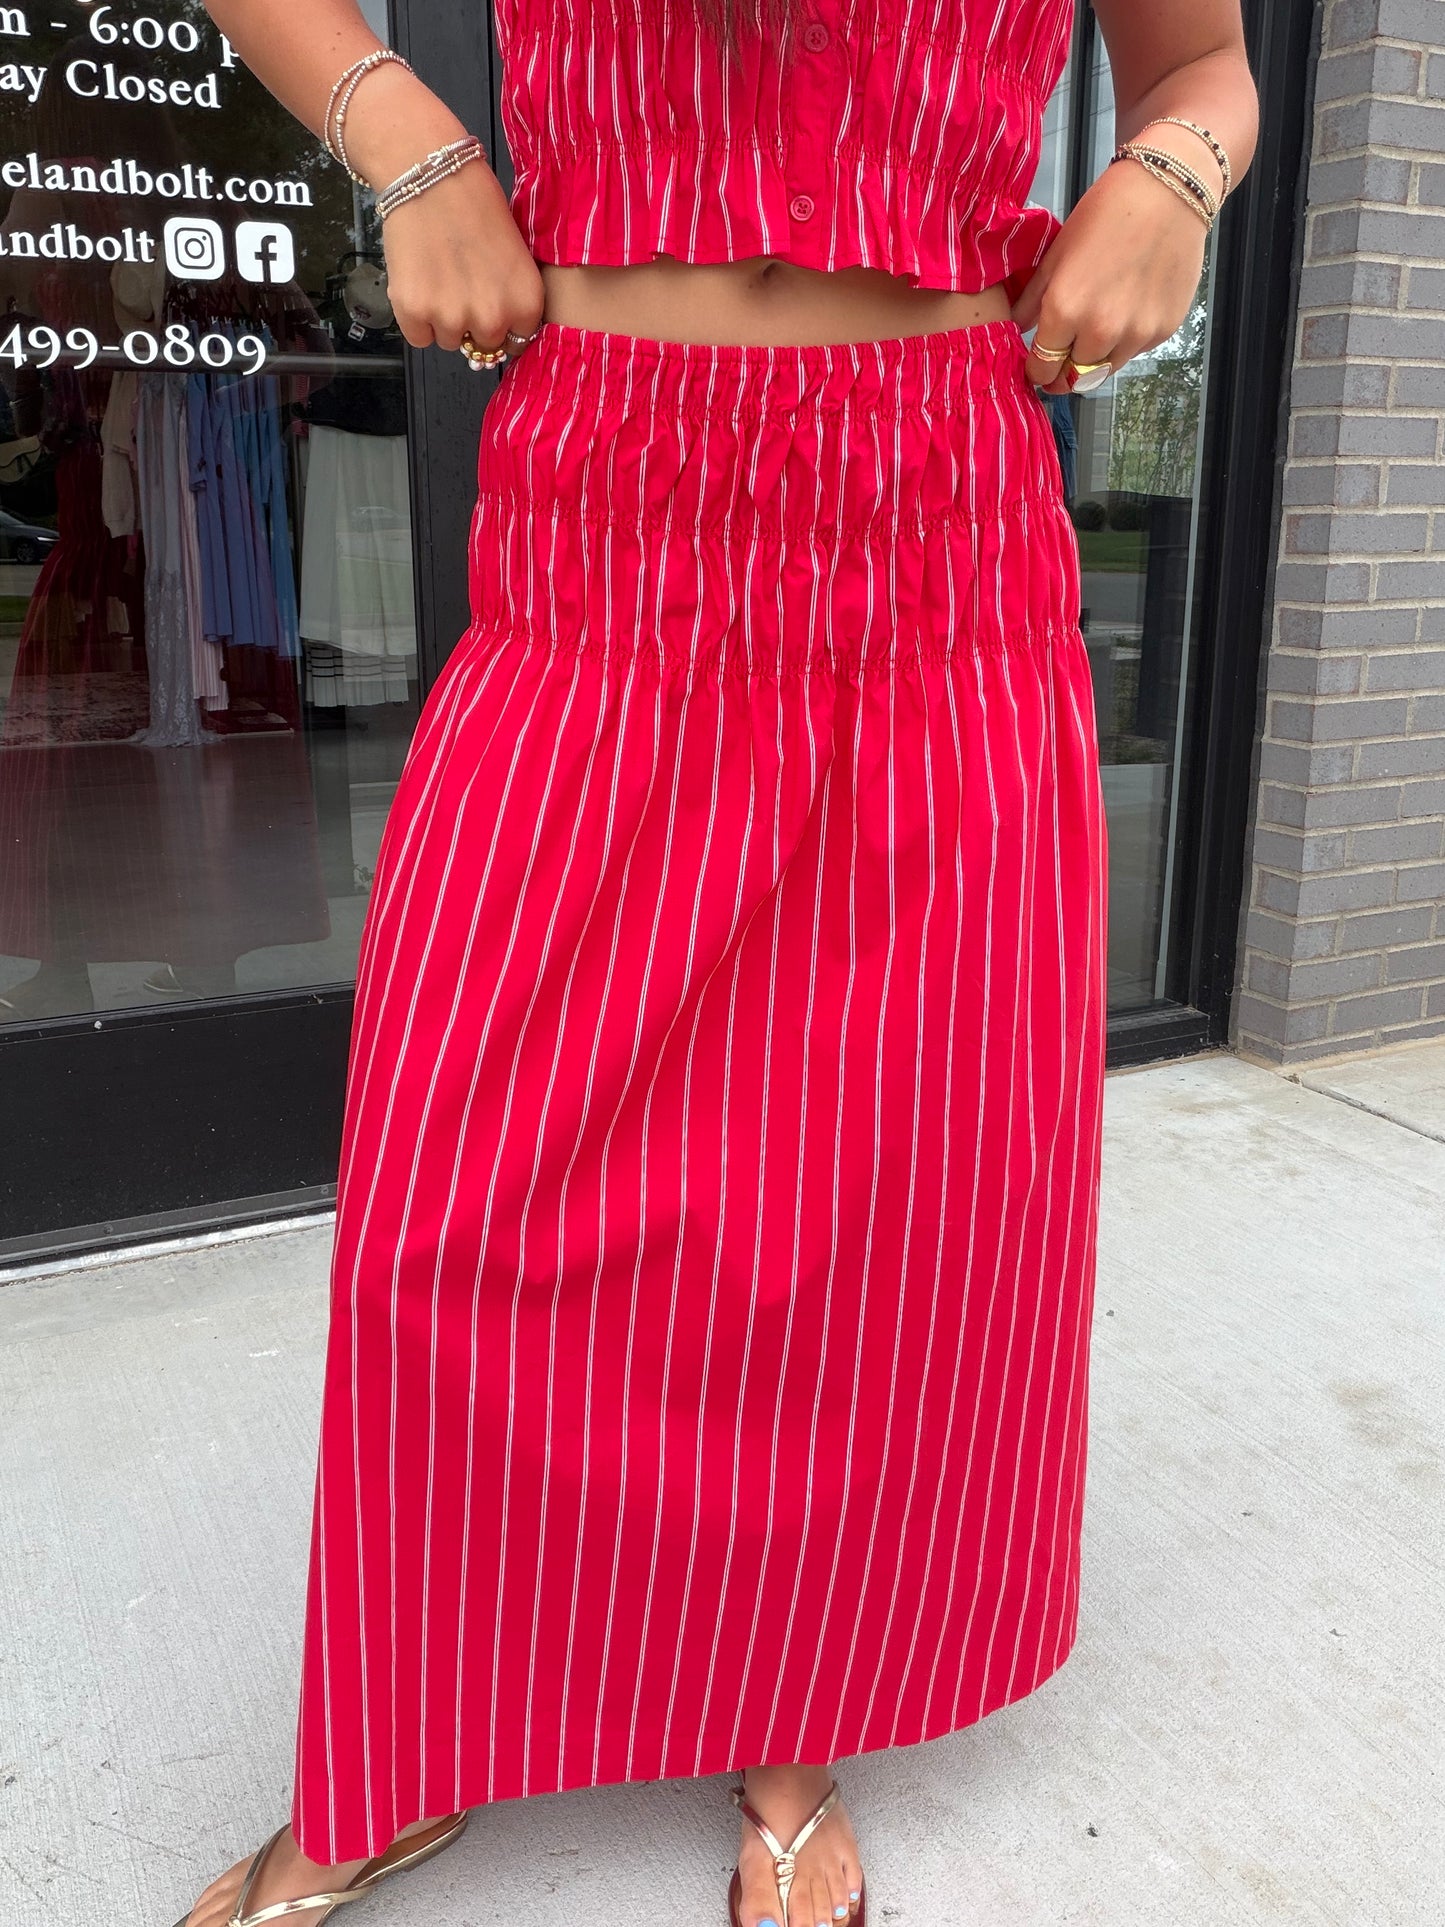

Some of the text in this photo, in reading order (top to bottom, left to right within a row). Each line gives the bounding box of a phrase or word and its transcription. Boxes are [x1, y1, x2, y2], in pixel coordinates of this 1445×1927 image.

[89, 6, 199, 53] 6:00
[0, 59, 222, 109] ay Closed
[1, 152, 314, 207] elandbolt.com
[0, 323, 266, 376] 499-0809
